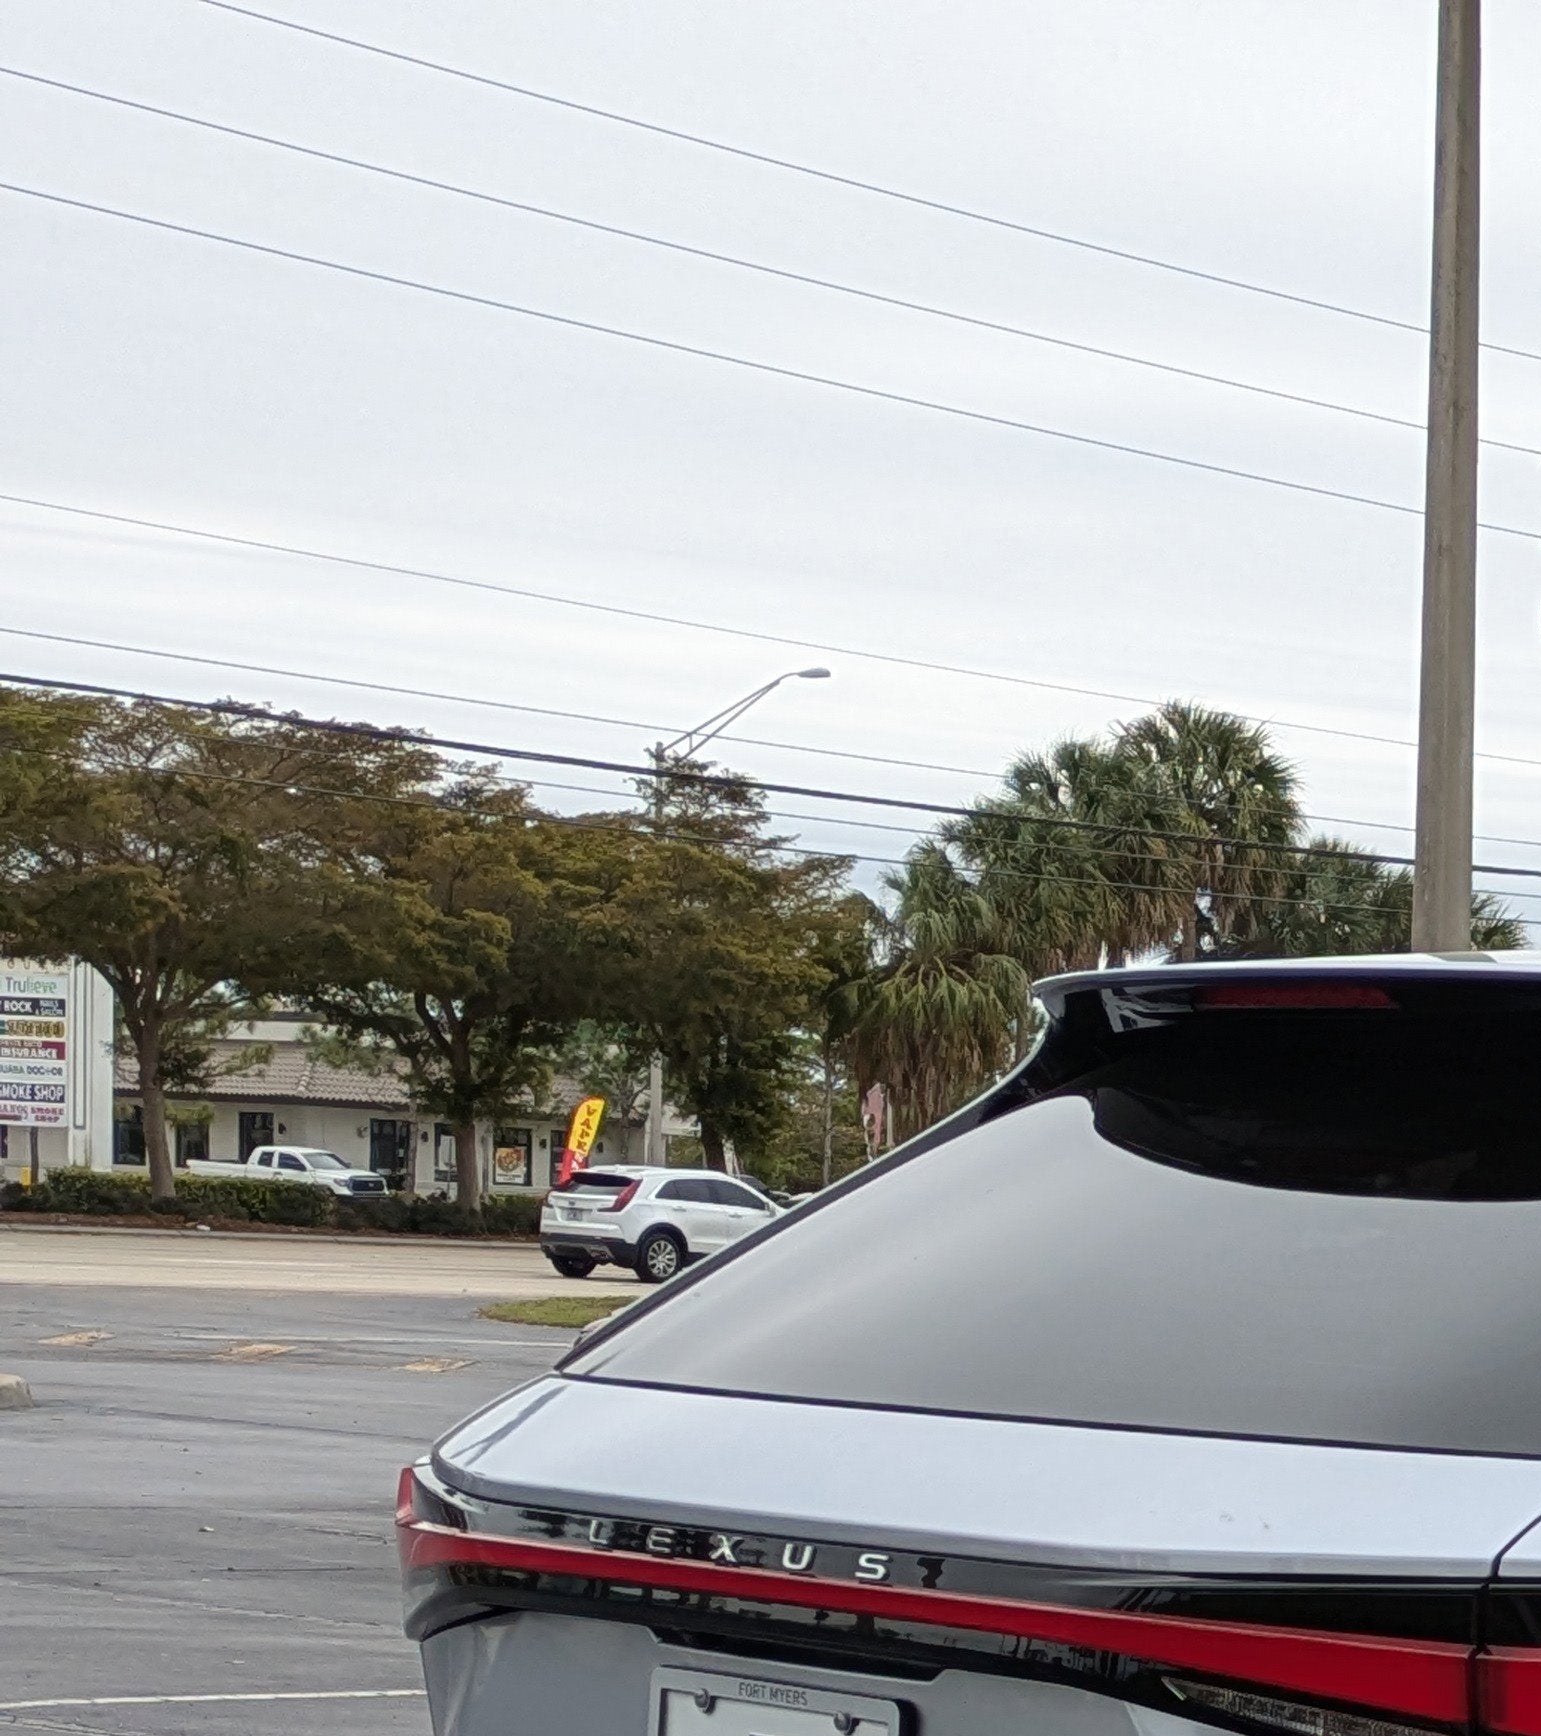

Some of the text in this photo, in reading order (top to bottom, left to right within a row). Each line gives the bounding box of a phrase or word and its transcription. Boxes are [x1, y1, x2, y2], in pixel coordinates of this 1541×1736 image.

[34, 1085, 63, 1101] SHOP
[589, 1519, 891, 1581] LEXUS
[738, 1682, 808, 1706] FORT MYERS
